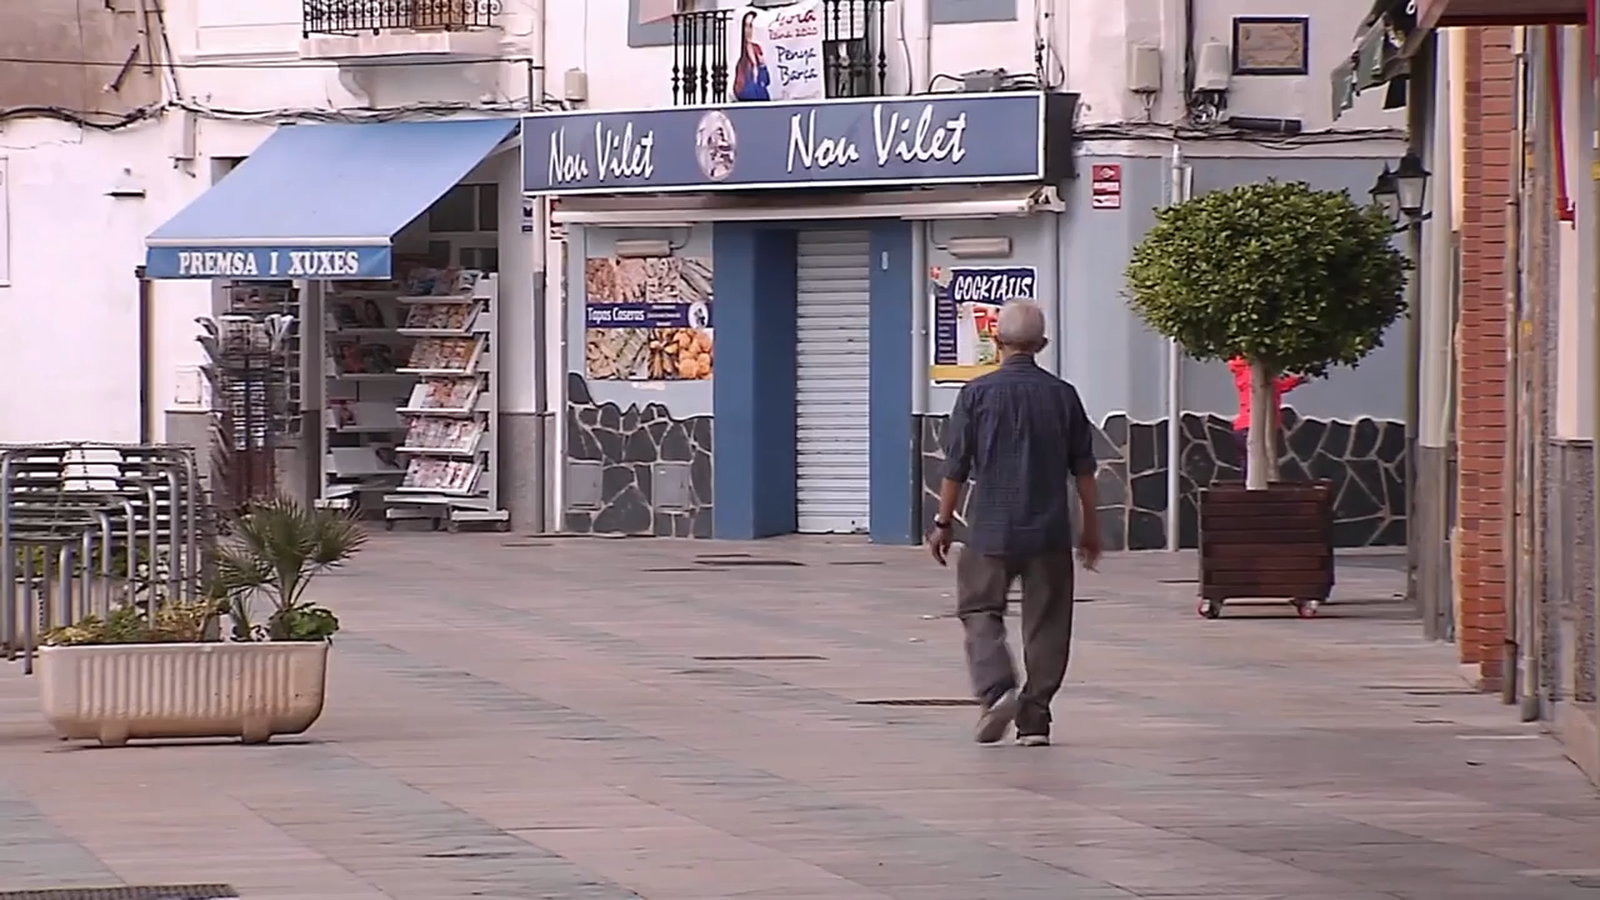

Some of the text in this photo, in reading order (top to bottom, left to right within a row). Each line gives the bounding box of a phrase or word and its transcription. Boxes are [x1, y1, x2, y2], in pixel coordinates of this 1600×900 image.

[777, 64, 818, 87] Barça
[787, 103, 967, 173] Nou Vilet
[548, 121, 653, 186] Nou Vilet
[178, 250, 360, 276] PREMSA I XUXES
[954, 273, 1033, 301] COCKTAILS
